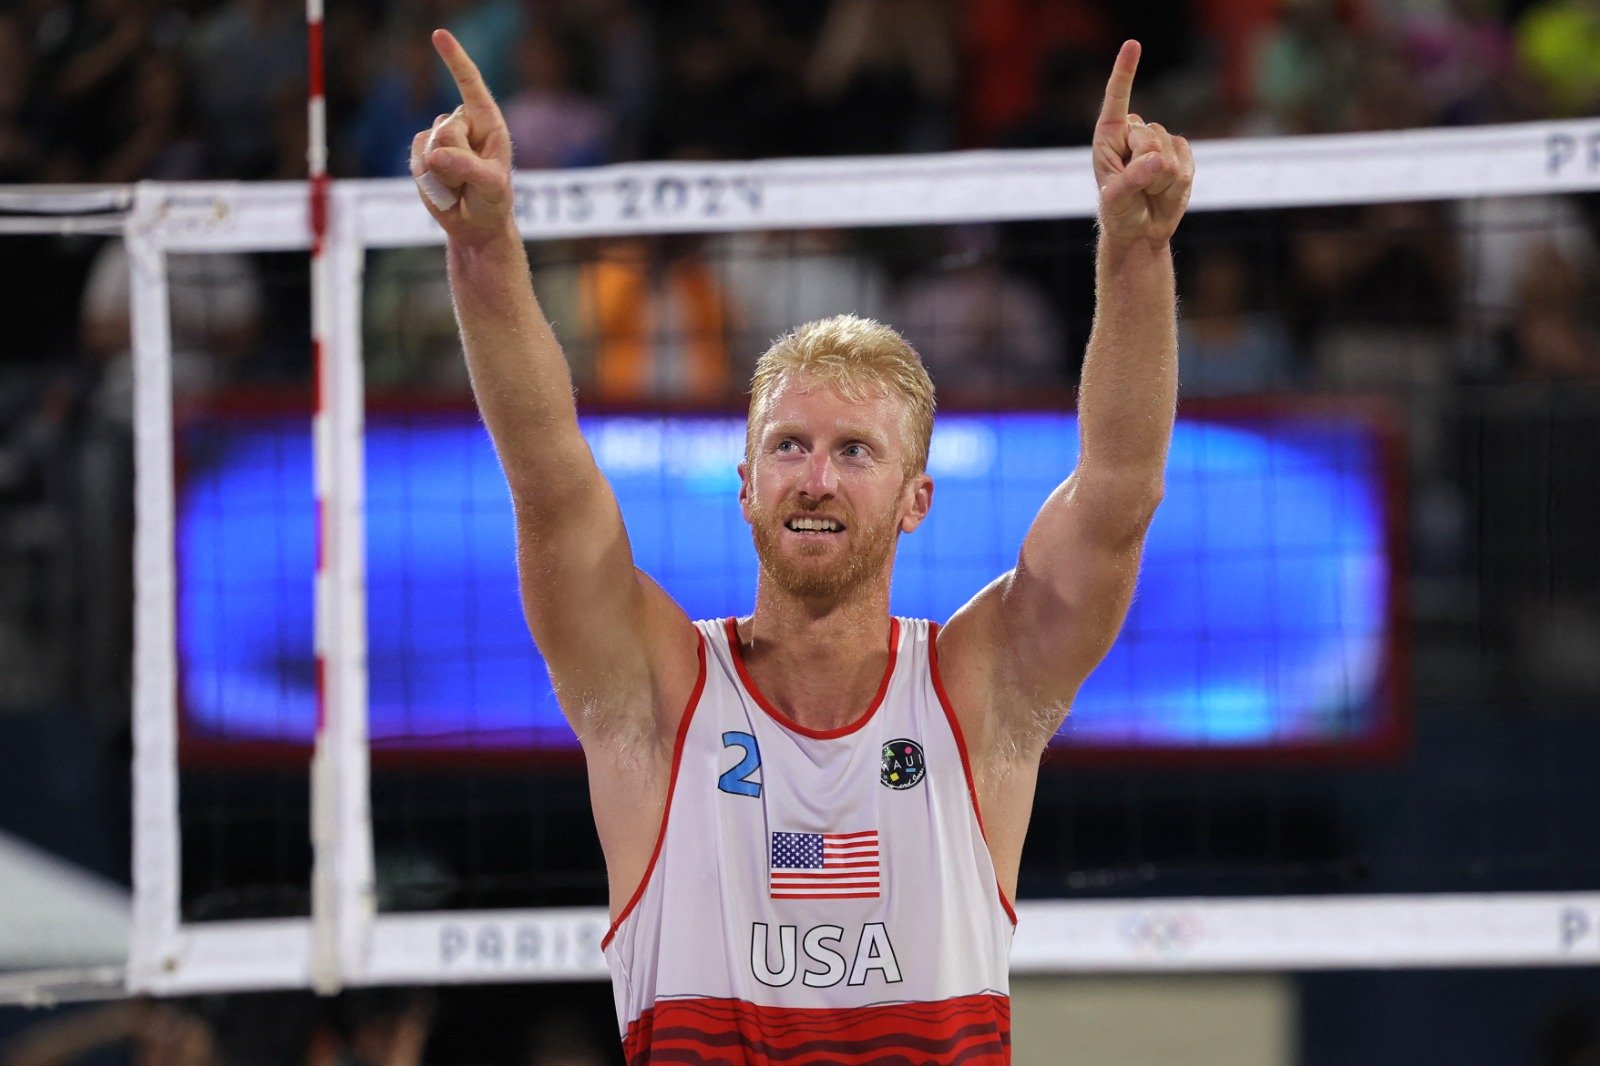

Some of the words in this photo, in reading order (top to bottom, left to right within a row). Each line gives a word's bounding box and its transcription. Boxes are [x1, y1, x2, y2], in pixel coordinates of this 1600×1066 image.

[614, 174, 764, 220] 2024
[717, 731, 763, 798] 2
[438, 920, 602, 966] PARIS
[751, 922, 903, 987] USA
